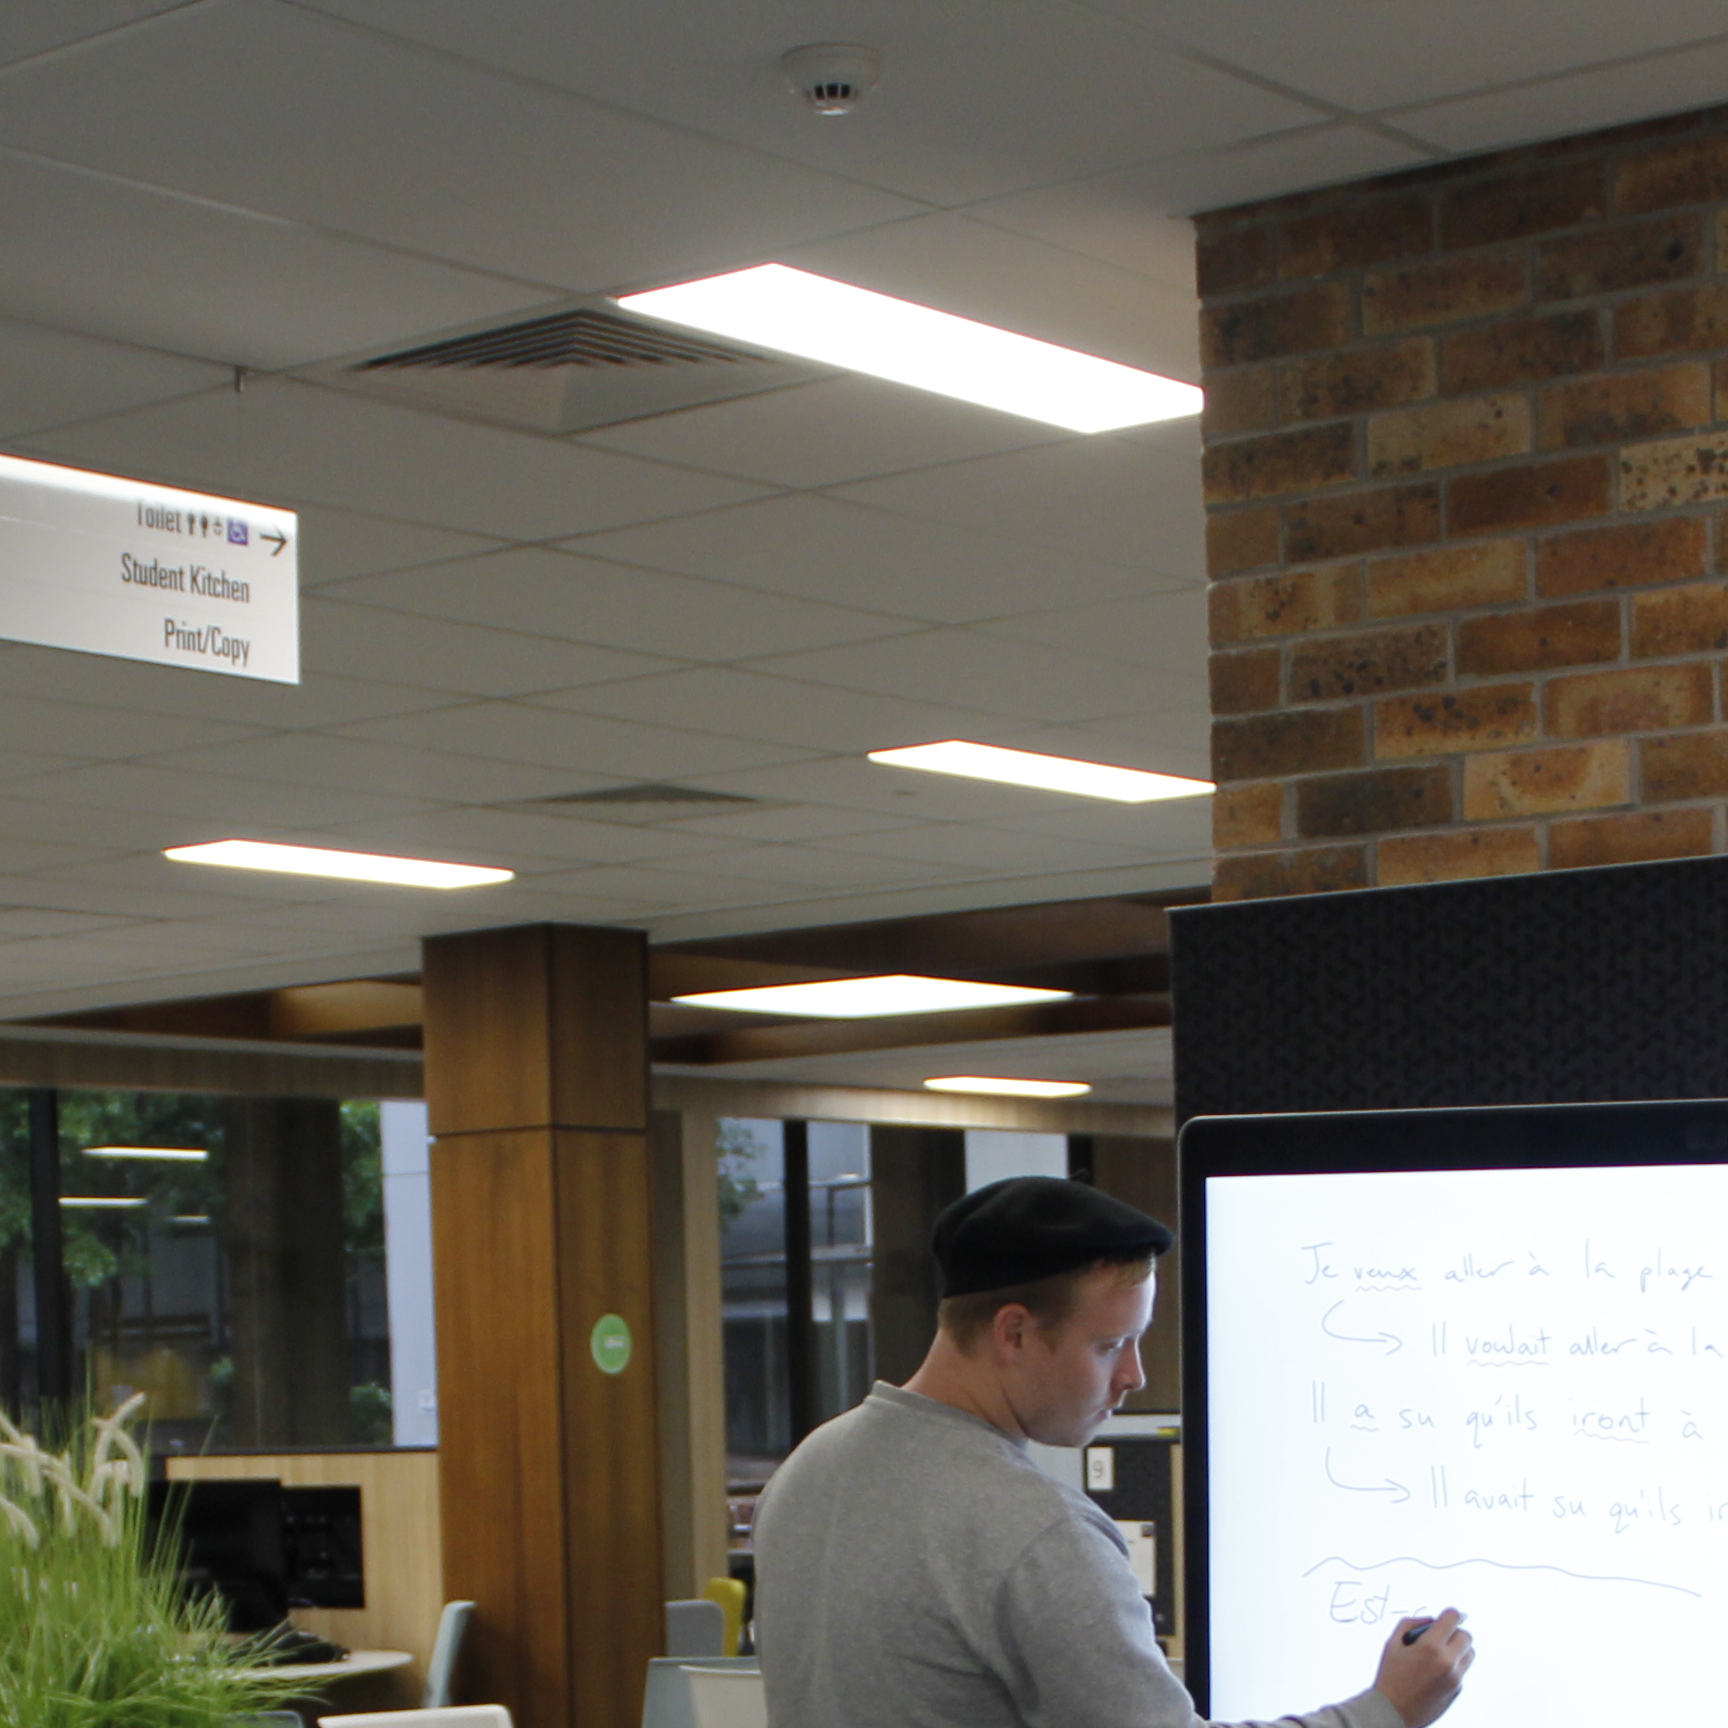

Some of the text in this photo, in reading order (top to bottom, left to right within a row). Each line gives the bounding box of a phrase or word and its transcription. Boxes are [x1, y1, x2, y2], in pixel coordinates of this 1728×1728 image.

[121, 552, 251, 604] Student Kitchen
[163, 617, 251, 667] Print/Copy
[1301, 1242, 1339, 1285] Je
[1353, 1264, 1419, 1283] veux
[1444, 1252, 1515, 1284] aller
[1527, 1251, 1551, 1278] à
[1585, 1239, 1617, 1280] la
[1466, 1323, 1553, 1358] voulait
[1569, 1326, 1637, 1358] aller
[1643, 1328, 1674, 1357] à
[1691, 1326, 1724, 1358] la
[1354, 1404, 1376, 1420] a
[1399, 1408, 1436, 1429] su
[1466, 1393, 1538, 1449] qu'ils
[1572, 1395, 1652, 1433] iront
[1681, 1409, 1705, 1441] à
[1463, 1477, 1536, 1512] avait
[1552, 1494, 1587, 1518] su
